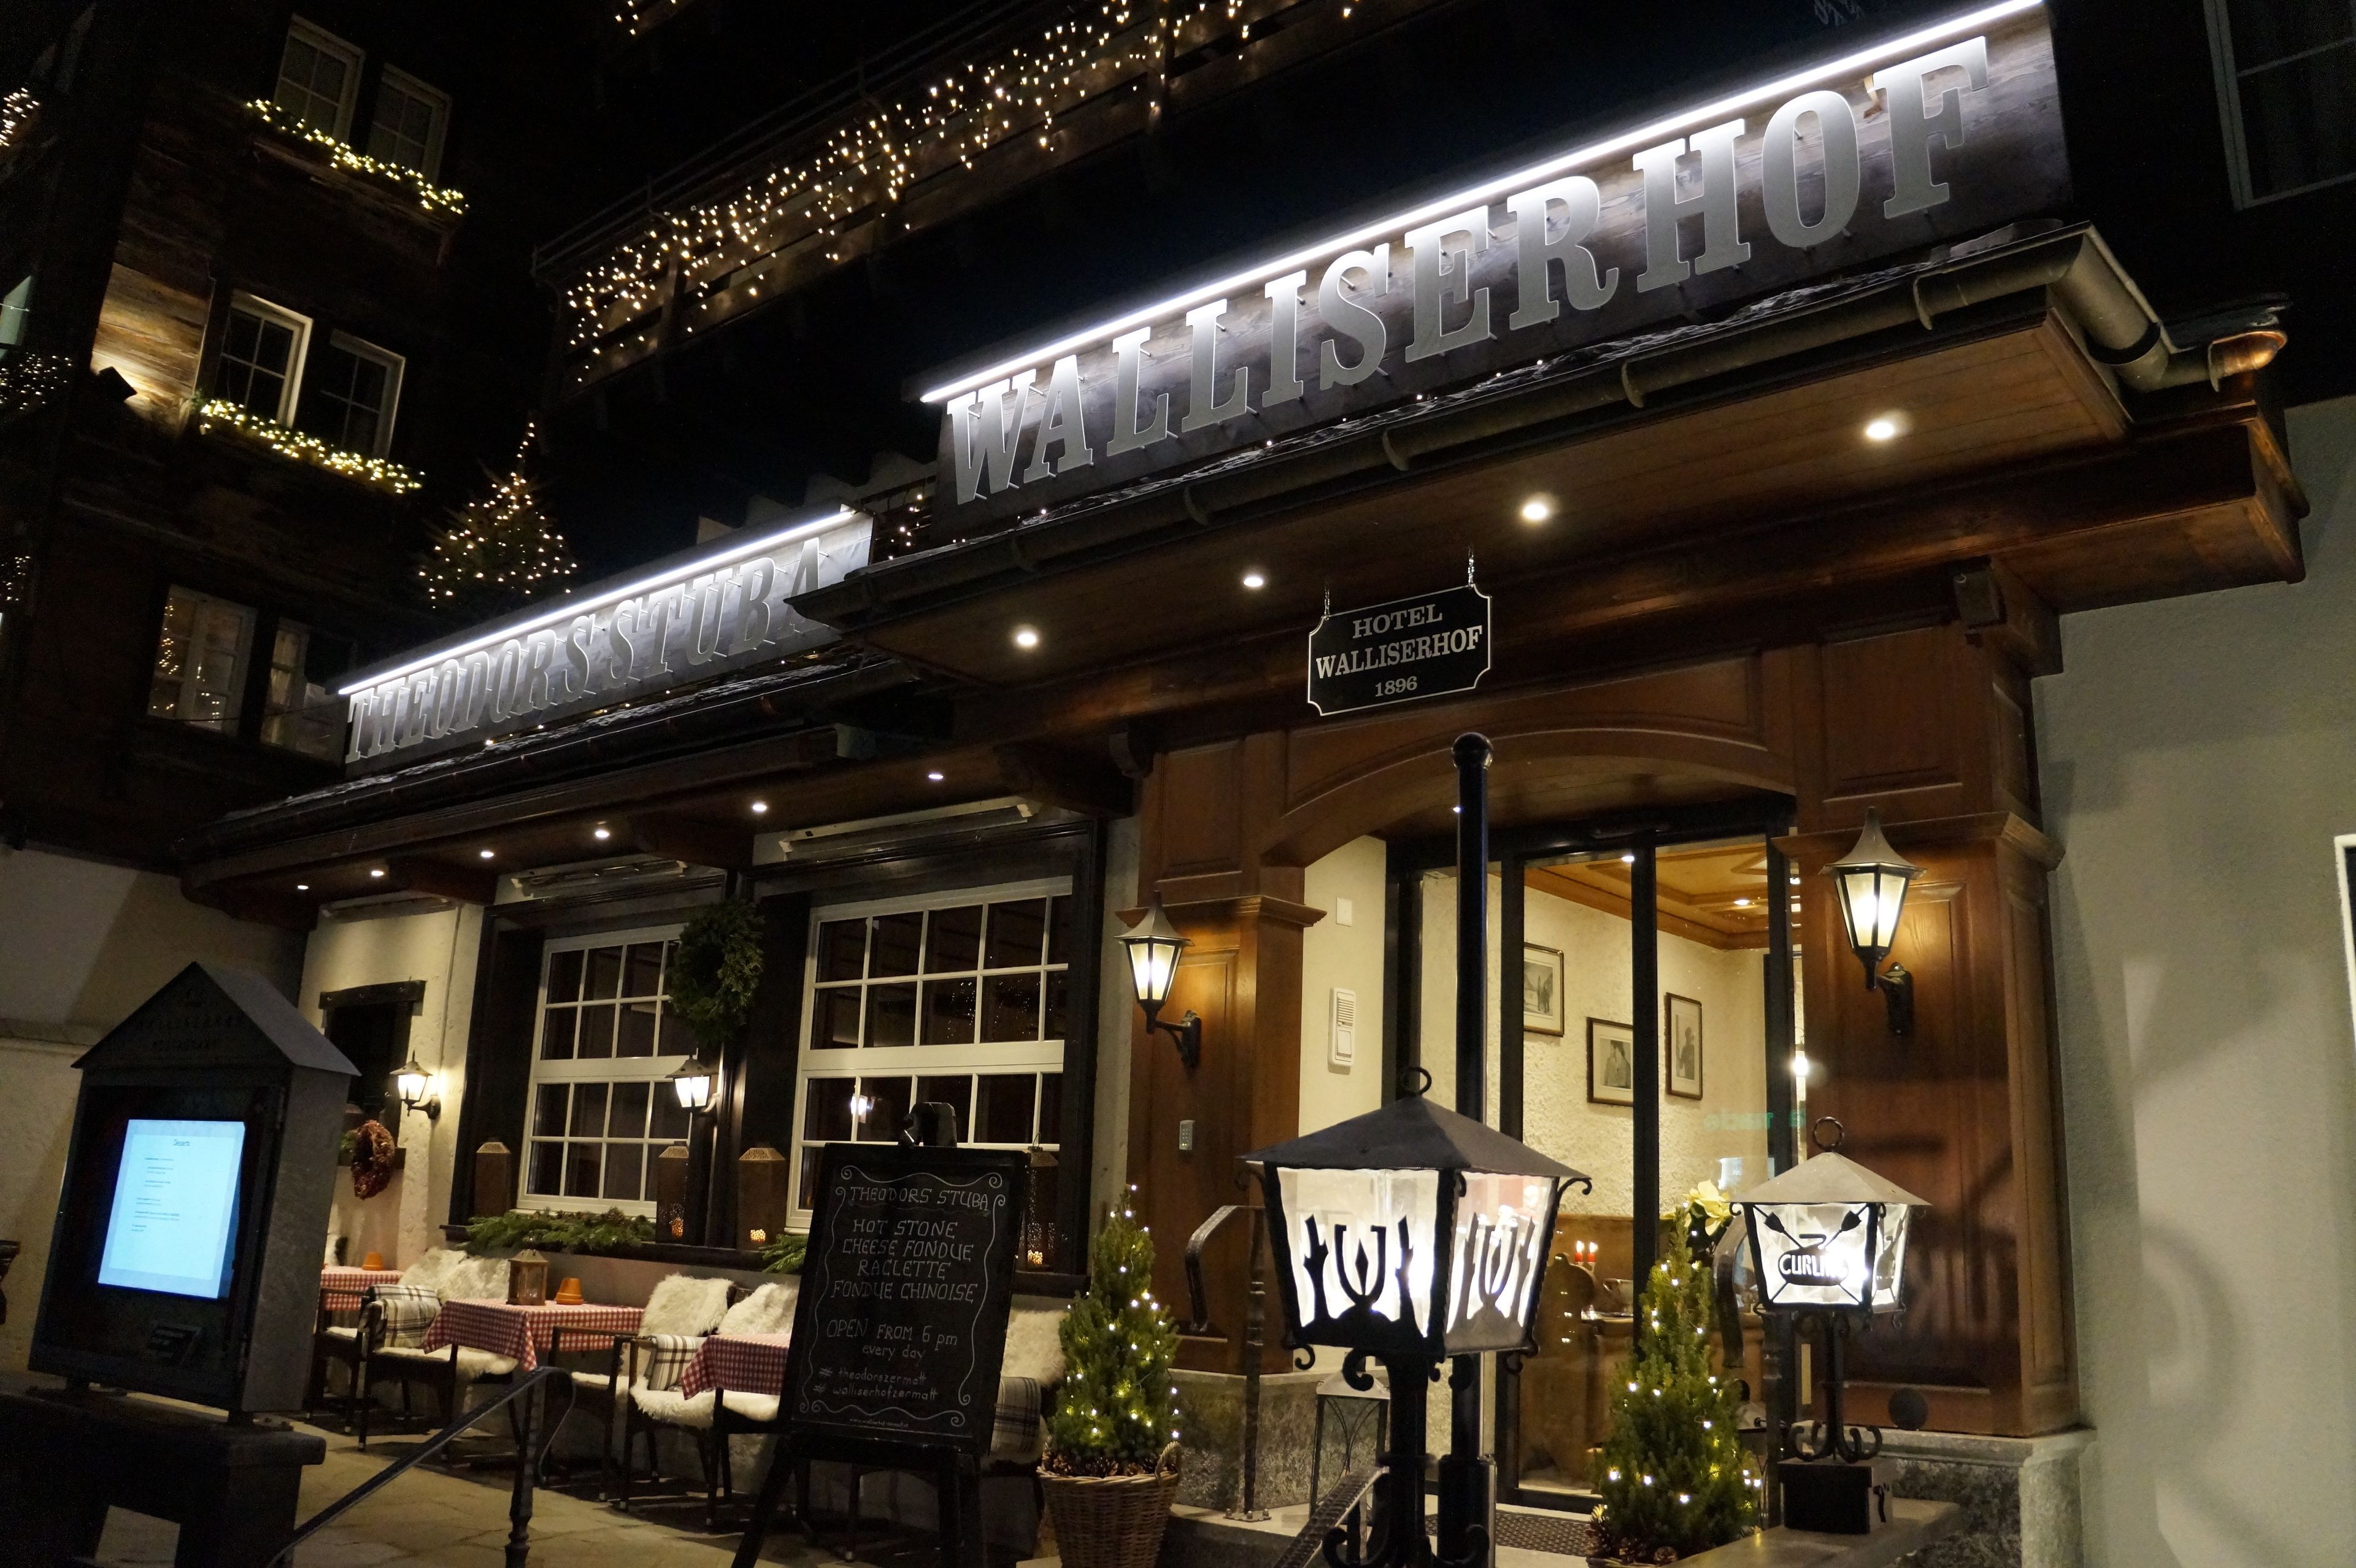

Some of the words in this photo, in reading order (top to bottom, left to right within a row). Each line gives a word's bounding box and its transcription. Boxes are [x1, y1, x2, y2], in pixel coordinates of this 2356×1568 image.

[946, 36, 1988, 504] WALLISERHOF
[1352, 604, 1442, 639] HOTEL
[1315, 625, 1482, 679] WALLISERHOF
[1375, 676, 1418, 697] 1896
[850, 1186, 932, 1203] THEODORS
[937, 1189, 988, 1210] STUBA
[852, 1218, 888, 1234] HOT
[894, 1220, 958, 1239] STONE
[842, 1238, 898, 1256] CHEESE
[903, 1240, 974, 1261] FONDUE
[857, 1259, 951, 1280] RACLETTE
[1779, 1254, 1849, 1279] CURLI
[831, 1280, 893, 1299] FONDUE
[900, 1283, 978, 1304] CHINOISE
[826, 1318, 869, 1338] OPEN
[877, 1324, 913, 1340] FROM
[922, 1325, 932, 1342] 6
[934, 1334, 957, 1351] pm
[862, 1344, 896, 1361] every
[902, 1344, 926, 1366] day
